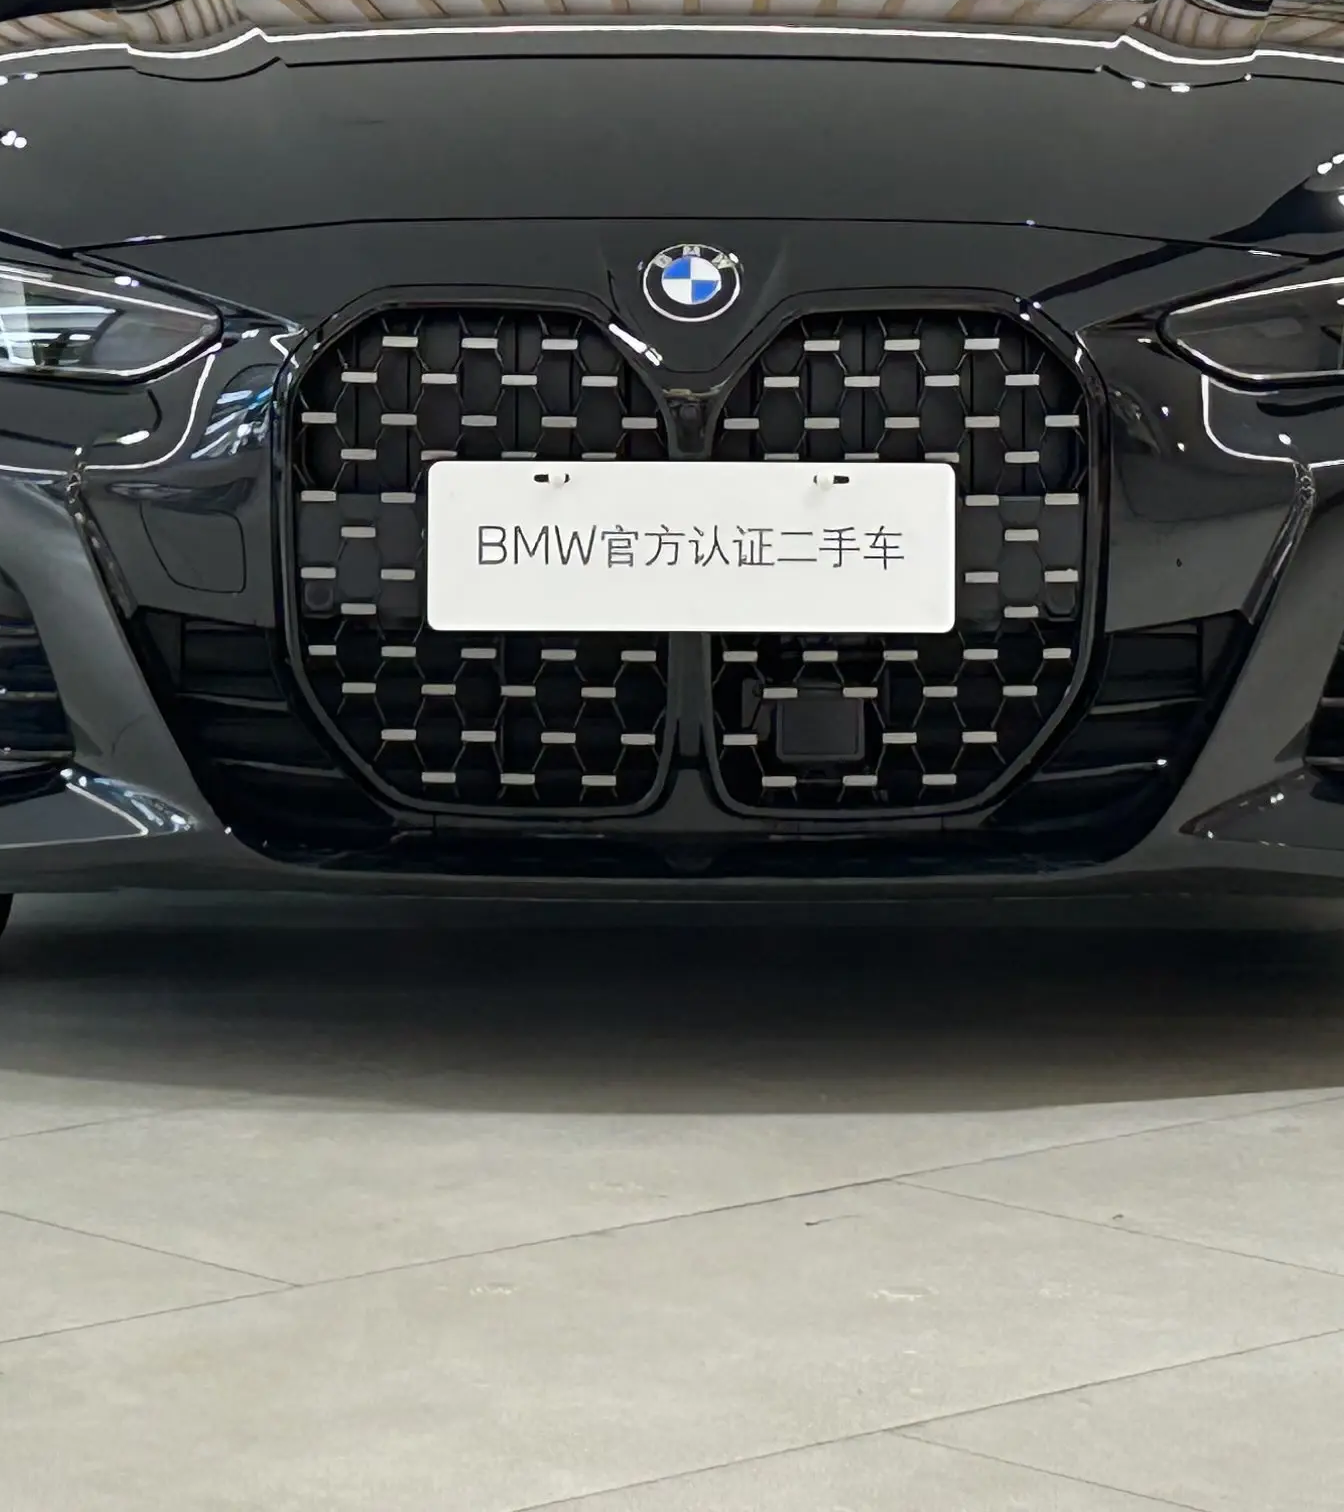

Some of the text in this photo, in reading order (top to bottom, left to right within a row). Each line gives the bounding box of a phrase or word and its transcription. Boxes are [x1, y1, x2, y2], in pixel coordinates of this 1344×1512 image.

[477, 524, 905, 571] BMW官方认证二手车
